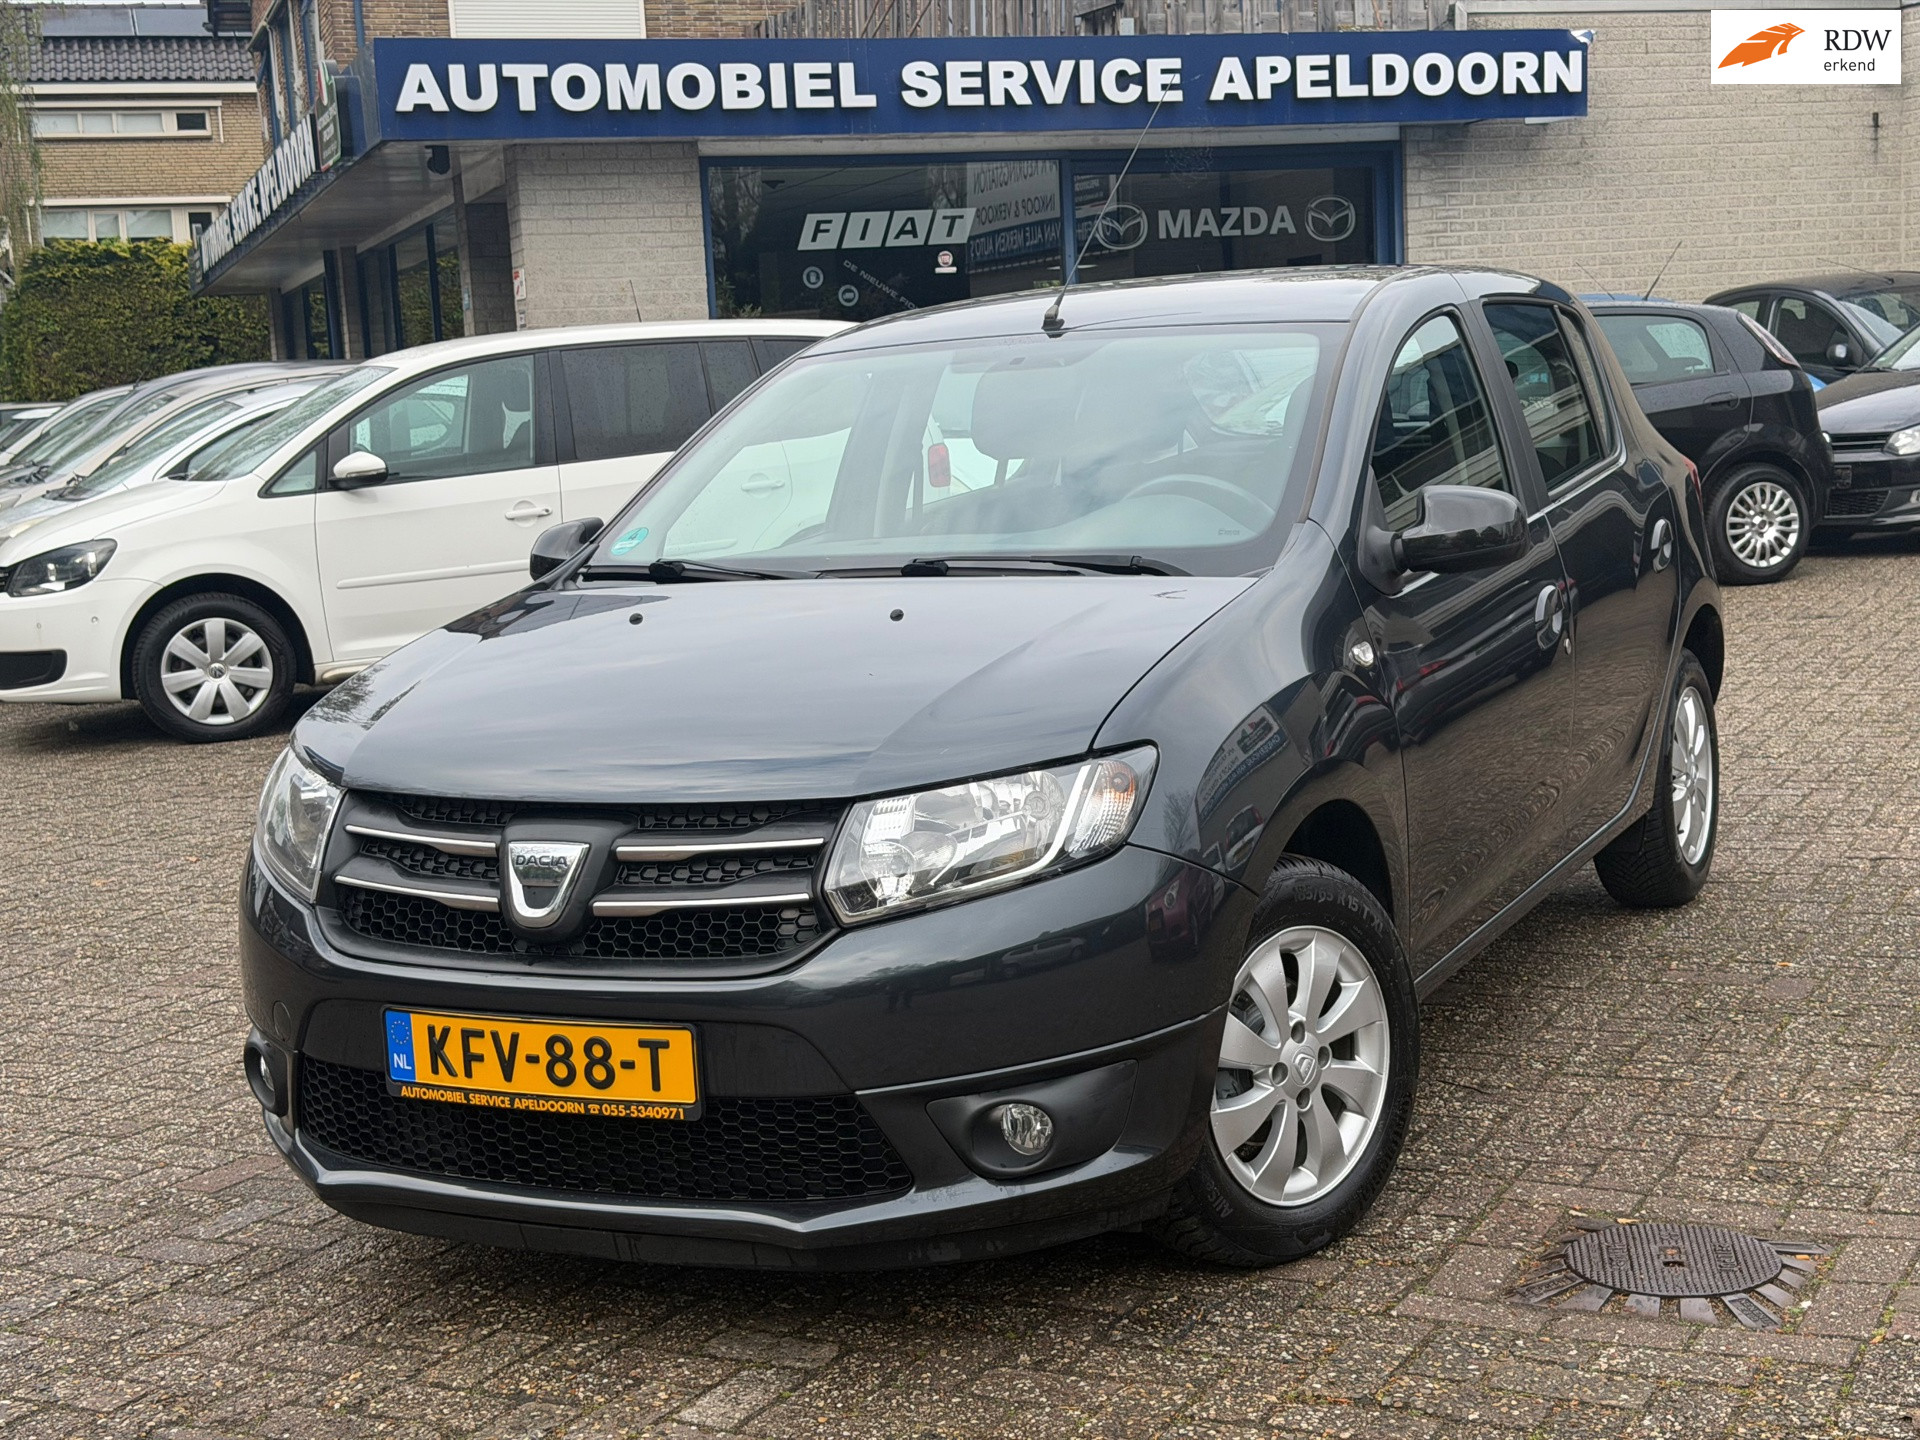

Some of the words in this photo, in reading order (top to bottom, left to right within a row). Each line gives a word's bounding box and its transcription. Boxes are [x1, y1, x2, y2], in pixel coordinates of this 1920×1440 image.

[395, 62, 877, 112] AUTOMOBIEL
[901, 57, 1183, 108] SERVICE
[1210, 50, 1583, 101] APELDOORN
[257, 113, 316, 220] APELDOORN
[808, 213, 967, 245] FIAT
[1158, 205, 1297, 239] MAZDA
[843, 260, 858, 273] DE
[860, 270, 898, 299] NIEUWE
[900, 296, 920, 310] FIO
[515, 855, 568, 868] DACIA
[393, 1053, 412, 1071] NL
[427, 1024, 670, 1092] KFV-88-T
[400, 1085, 468, 1104] AUTOMOBIEL
[469, 1093, 511, 1109] SERVICE
[513, 1097, 585, 1115] APELDOORN
[602, 1104, 685, 1120] 055-5340971
